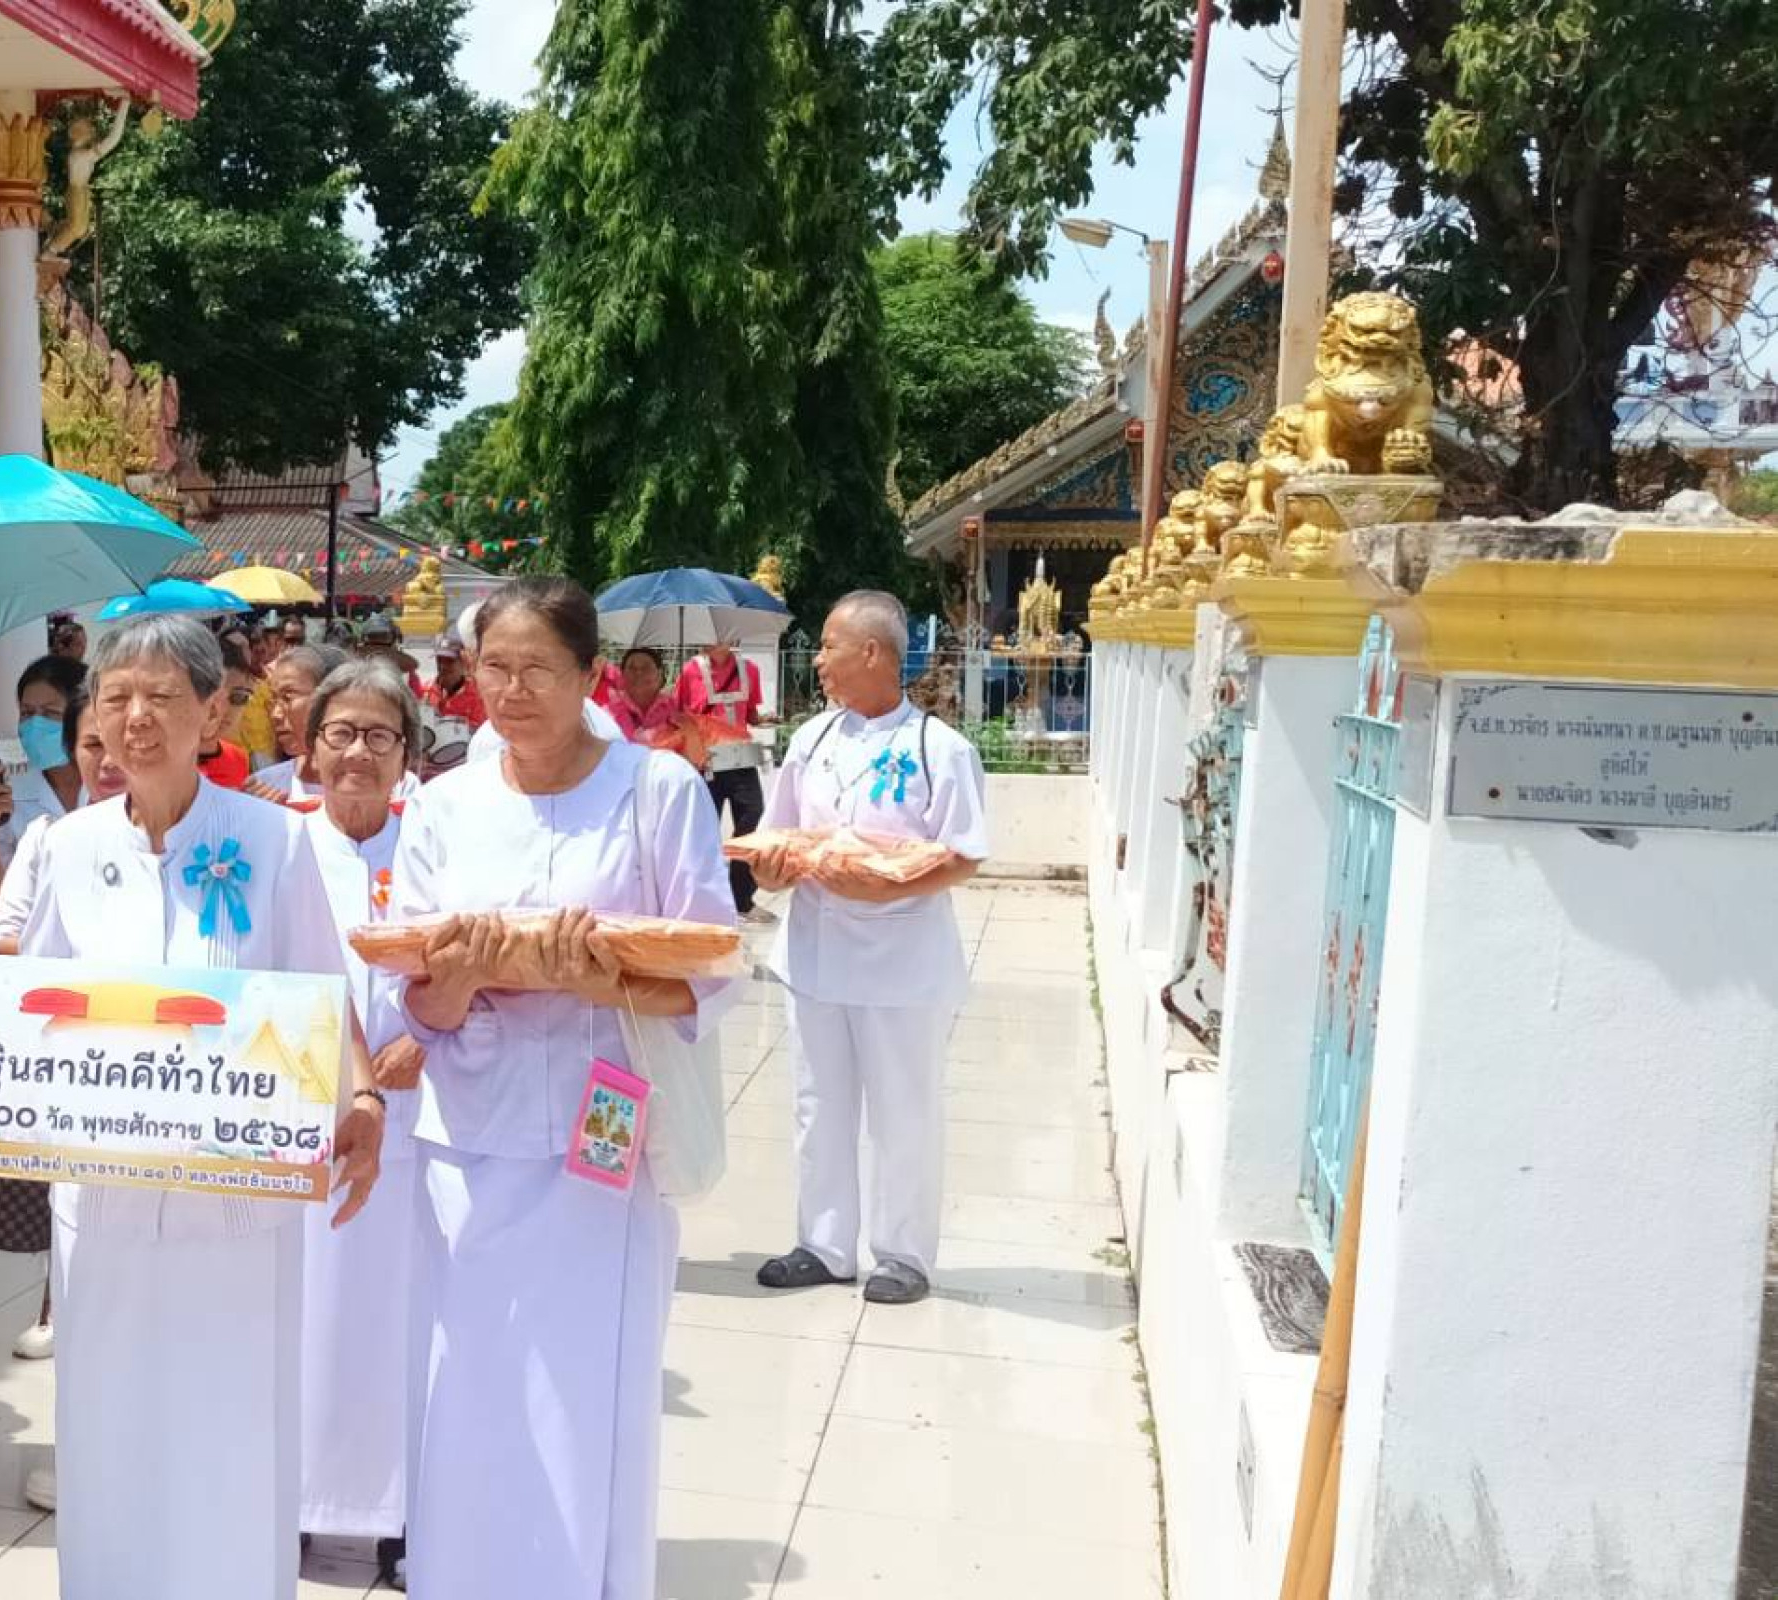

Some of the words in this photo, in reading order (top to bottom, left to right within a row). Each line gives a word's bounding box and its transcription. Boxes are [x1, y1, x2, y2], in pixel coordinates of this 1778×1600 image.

[46, 1108, 73, 1132] วัด
[80, 1111, 202, 1143] พุทธศักราช
[213, 1115, 322, 1151] ๒๕๖๘
[171, 1163, 184, 1181] ปี
